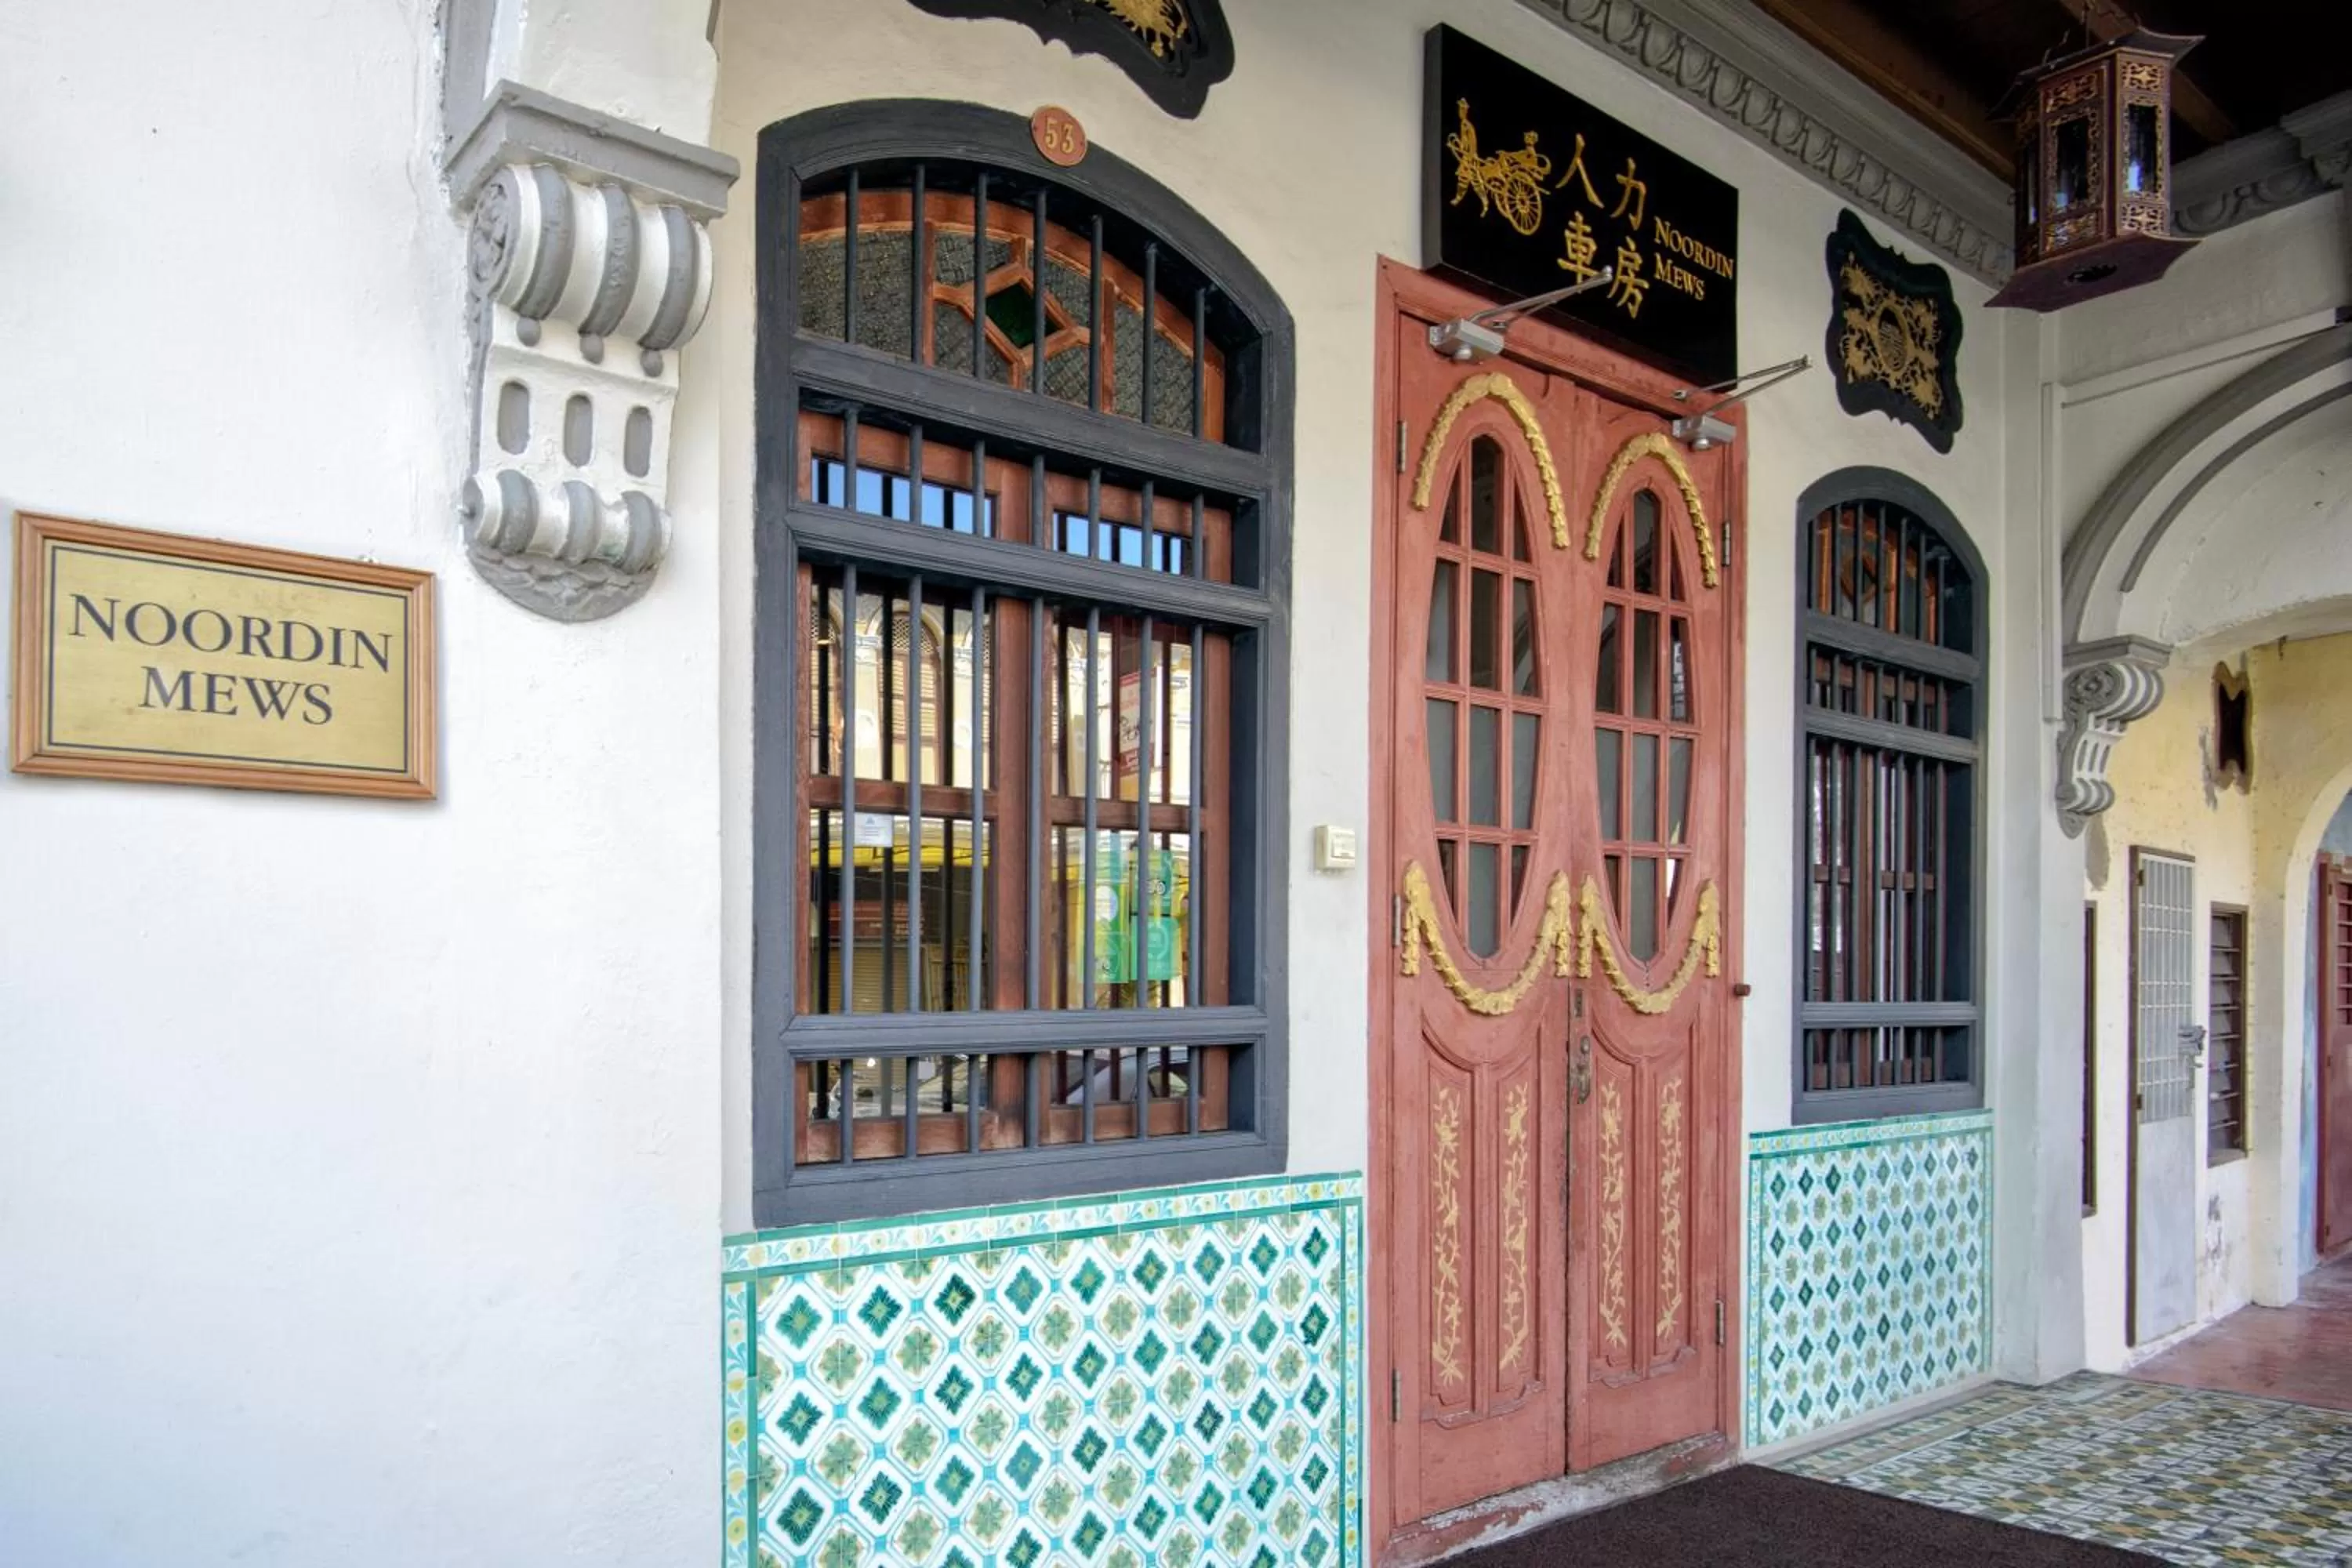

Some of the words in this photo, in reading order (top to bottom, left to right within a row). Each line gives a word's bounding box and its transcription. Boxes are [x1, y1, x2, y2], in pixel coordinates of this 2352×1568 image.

[1044, 116, 1074, 154] 53
[1555, 132, 1647, 230] 人力
[1556, 211, 1650, 318] 車房
[1653, 216, 1734, 280] NOORDIN
[1653, 252, 1705, 301] MEWS
[68, 593, 394, 673] NOORDIN
[138, 665, 333, 725] MEWS
